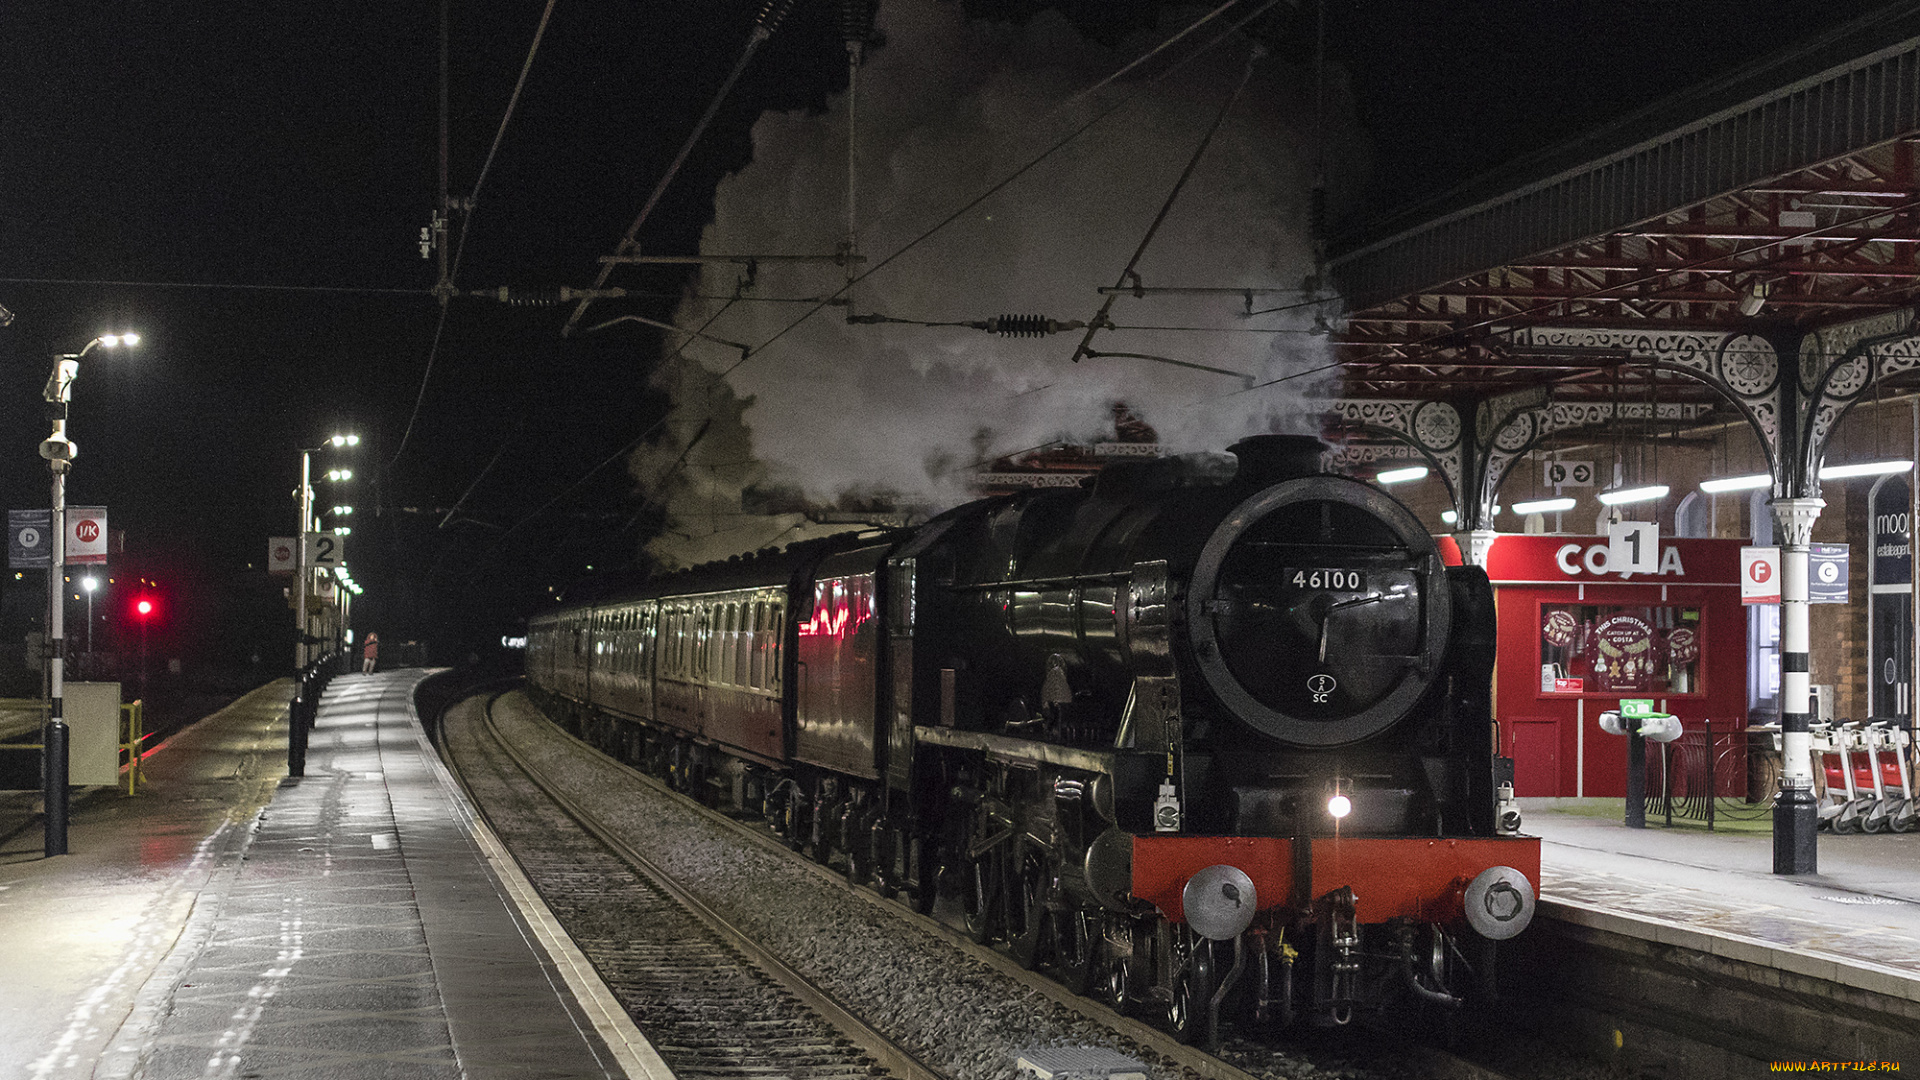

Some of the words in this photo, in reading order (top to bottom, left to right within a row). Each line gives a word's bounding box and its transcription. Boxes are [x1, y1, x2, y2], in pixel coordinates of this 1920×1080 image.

[25, 533, 35, 542] D
[79, 525, 97, 538] J/K
[315, 537, 334, 563] 2
[1624, 530, 1640, 564] 1
[1556, 544, 1685, 579] COA
[1292, 570, 1360, 589] 46100
[1755, 562, 1766, 580] F
[1824, 567, 1832, 577] C
[1595, 620, 1611, 635] THIS
[1611, 616, 1653, 635] CHRISTMAS
[1312, 693, 1328, 703] SC
